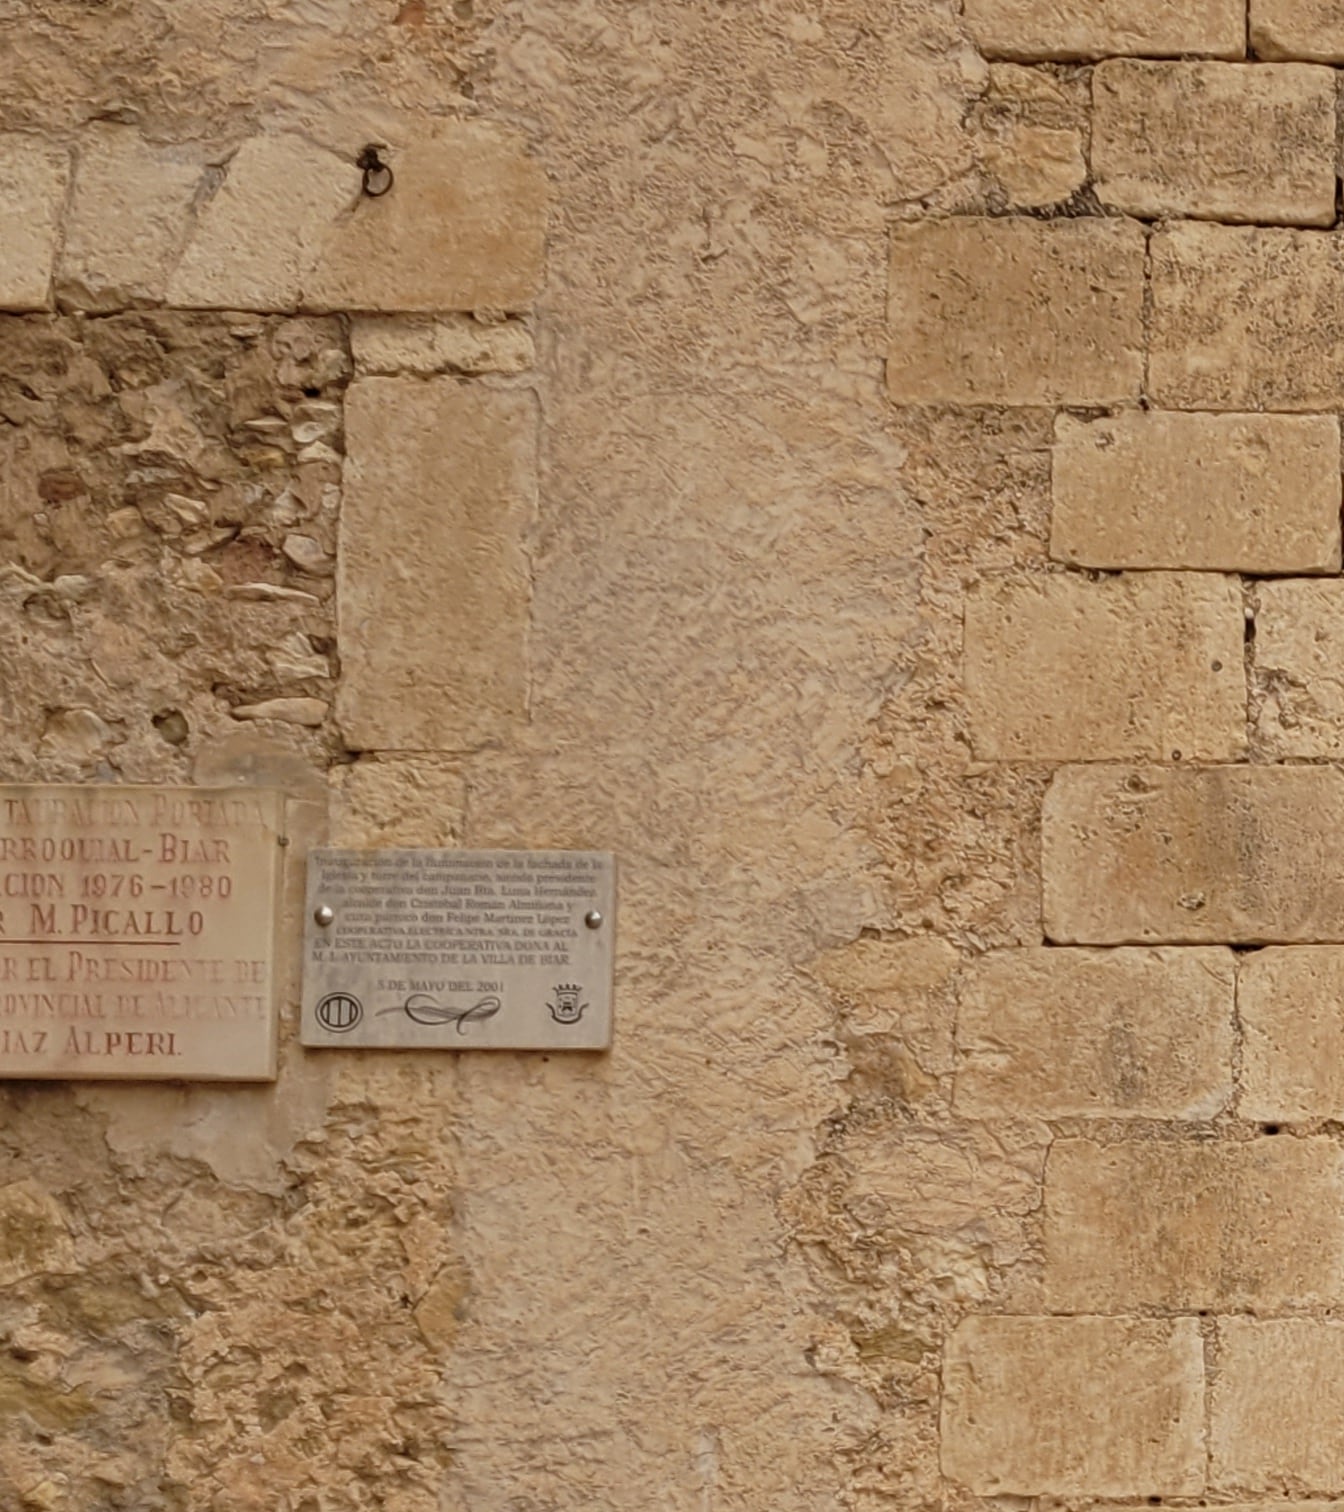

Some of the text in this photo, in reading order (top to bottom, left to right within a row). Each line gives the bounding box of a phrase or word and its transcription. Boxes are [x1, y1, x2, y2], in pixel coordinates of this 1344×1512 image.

[440, 885, 471, 896] Juan
[421, 912, 443, 923] don
[447, 912, 480, 923] Felipe
[406, 939, 422, 950] LA
[424, 939, 511, 950] COOPERATIVA
[553, 940, 568, 951] AL
[441, 952, 458, 964] DE
[463, 952, 478, 964] LA
[480, 952, 515, 964] VILLA
[518, 952, 537, 964] DE
[26, 957, 56, 982] EL
[66, 950, 224, 983] PRESIDENTE
[234, 960, 266, 984] DE
[387, 980, 406, 991] DE
[409, 980, 446, 991] MAYO
[448, 981, 475, 992] DEL
[477, 981, 504, 992] 2001
